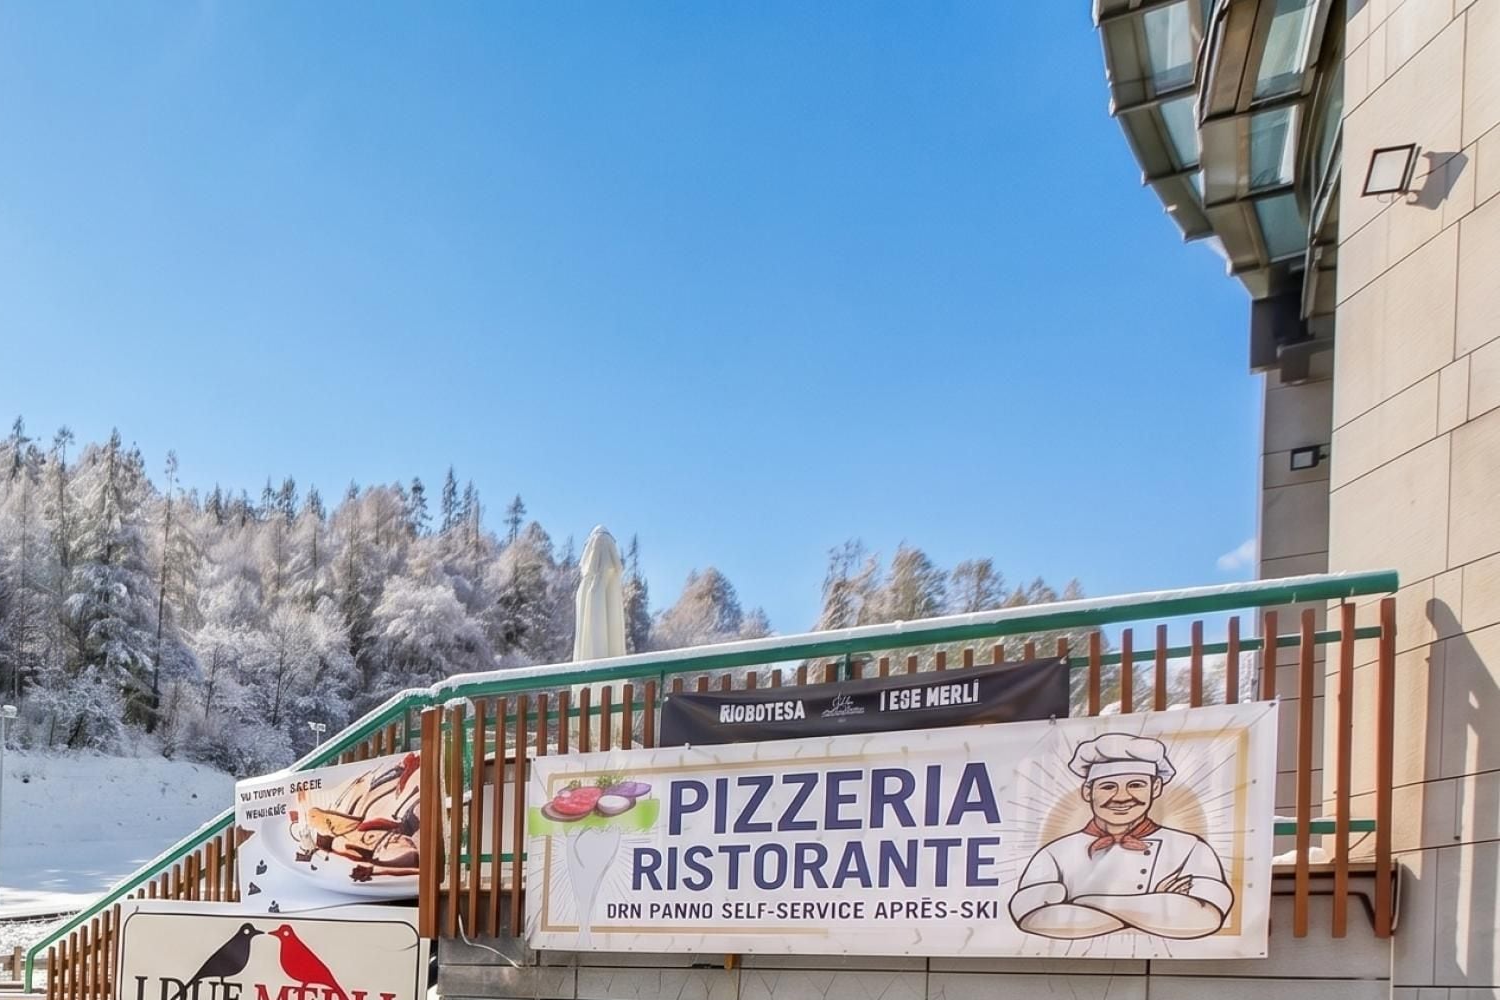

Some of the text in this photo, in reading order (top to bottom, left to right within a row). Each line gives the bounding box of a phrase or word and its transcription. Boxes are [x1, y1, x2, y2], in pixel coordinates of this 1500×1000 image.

[668, 762, 1001, 836] PIZZERIA
[631, 837, 1001, 891] RISTORANTE
[607, 903, 642, 919] DRN
[650, 903, 713, 919] PANNO
[722, 902, 865, 919] SELF-SERVICE
